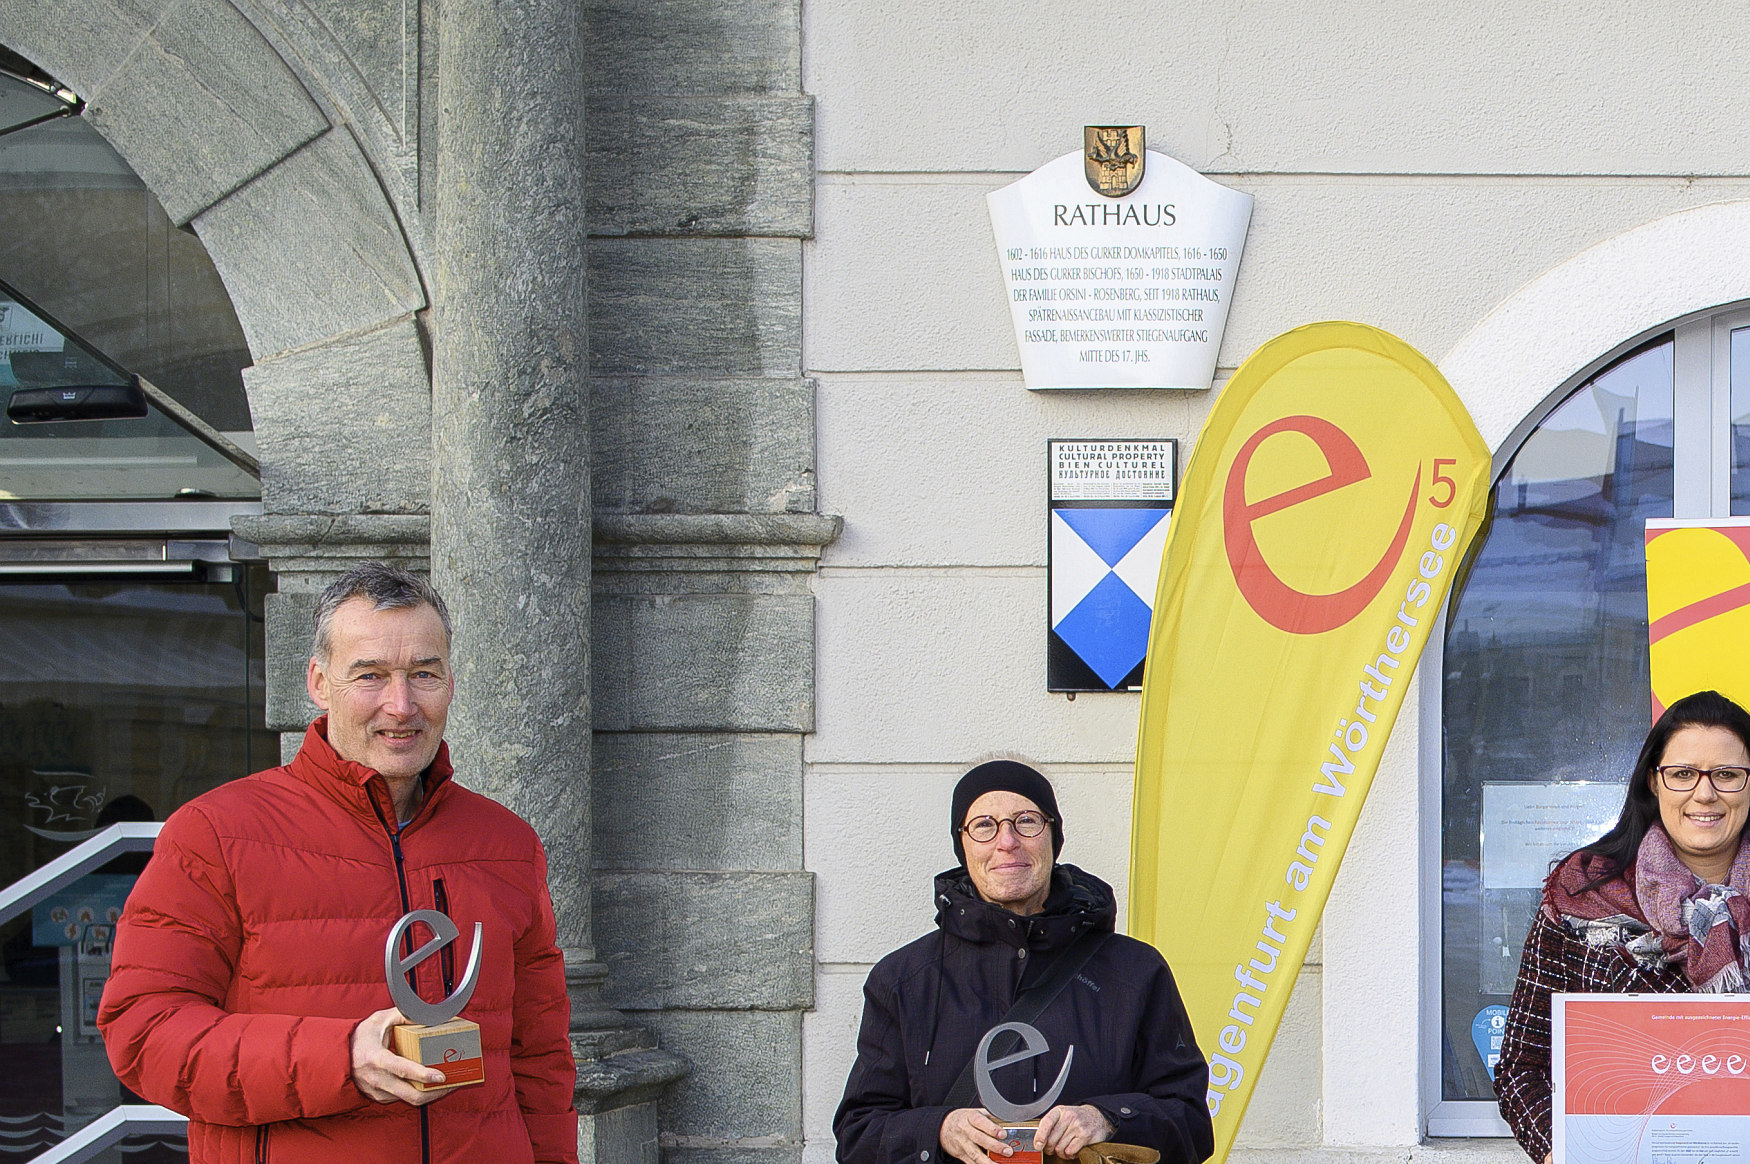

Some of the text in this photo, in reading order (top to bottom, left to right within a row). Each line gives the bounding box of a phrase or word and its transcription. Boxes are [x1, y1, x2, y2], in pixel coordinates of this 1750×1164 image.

[1053, 203, 1177, 227] RATHAUS
[1006, 247, 1023, 261] 1602
[1030, 247, 1048, 260] 1616
[1049, 247, 1072, 260] HAUS
[1073, 247, 1089, 260] DES
[1090, 246, 1121, 260] GURKER
[1123, 246, 1181, 261] DOMKAPITELS,
[1183, 247, 1201, 260] 1616
[1209, 247, 1228, 261] 1650
[1011, 267, 1032, 281] HAUS
[1033, 267, 1048, 280] DES
[1050, 267, 1081, 280] GURKER
[1083, 267, 1124, 282] BISCHOFS,
[1126, 267, 1144, 280] 1650
[1152, 267, 1170, 280] 1918
[1171, 267, 1223, 281] STADTPALAIS
[1013, 288, 1027, 302] DER
[1029, 288, 1057, 301] FAMILIE
[1058, 288, 1086, 301] ORSINI
[1094, 288, 1142, 302] ROSENBERG,
[1144, 288, 1160, 300] SEIT
[1161, 288, 1180, 300] 1918
[1181, 288, 1221, 303] RATHAUS,
[1028, 306, 1204, 322] SPÄTRENAISSANCEBAU MIT KLASSIZISTISCHER
[1024, 329, 1208, 343] FASSADE, BEMERKENSWERTER STIEGENAUFGANG
[1079, 350, 1151, 364] MITTE DES 17. JHS.
[1059, 444, 1165, 452] KULTURDENKMAL
[1058, 452, 1165, 460] CULTURAL PROPERTY
[1058, 461, 1165, 469] BIEN CULTUREL
[1285, 814, 1332, 892] am
[1311, 522, 1457, 798] Wörthersee
